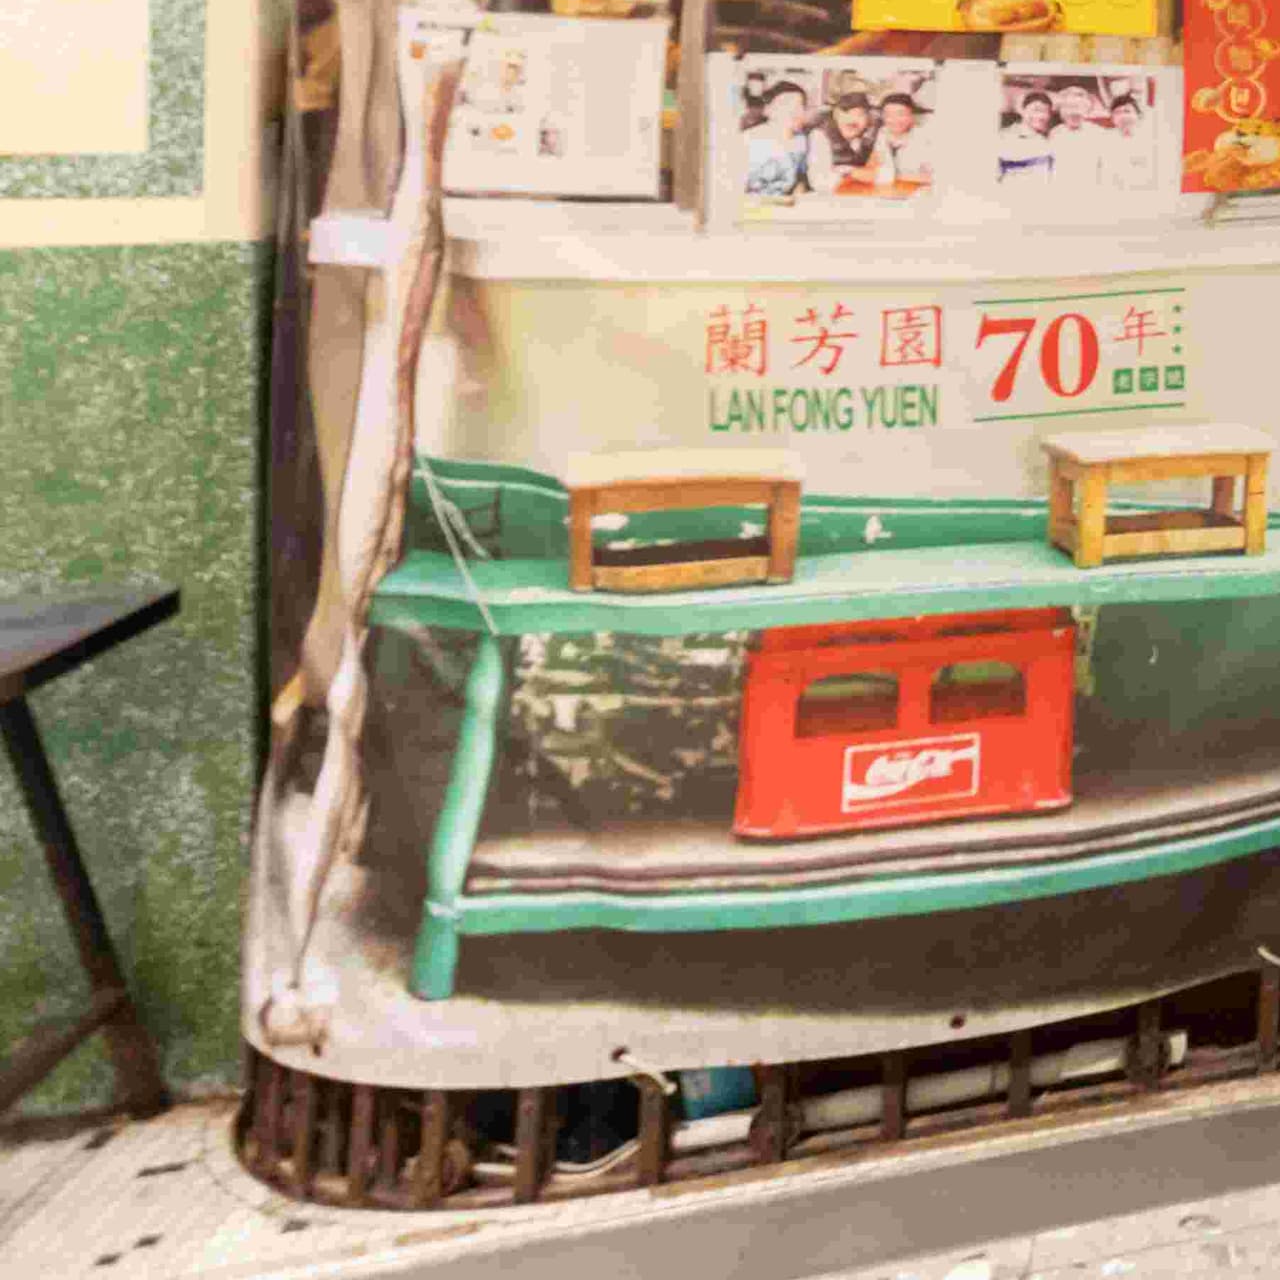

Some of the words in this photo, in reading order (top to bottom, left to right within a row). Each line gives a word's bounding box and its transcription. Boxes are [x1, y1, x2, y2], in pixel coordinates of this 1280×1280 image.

[704, 301, 943, 377] 蘭芳園
[975, 312, 1100, 404] 70
[708, 386, 766, 430] LAN
[772, 384, 854, 431] FONG
[860, 381, 938, 427] YUEN
